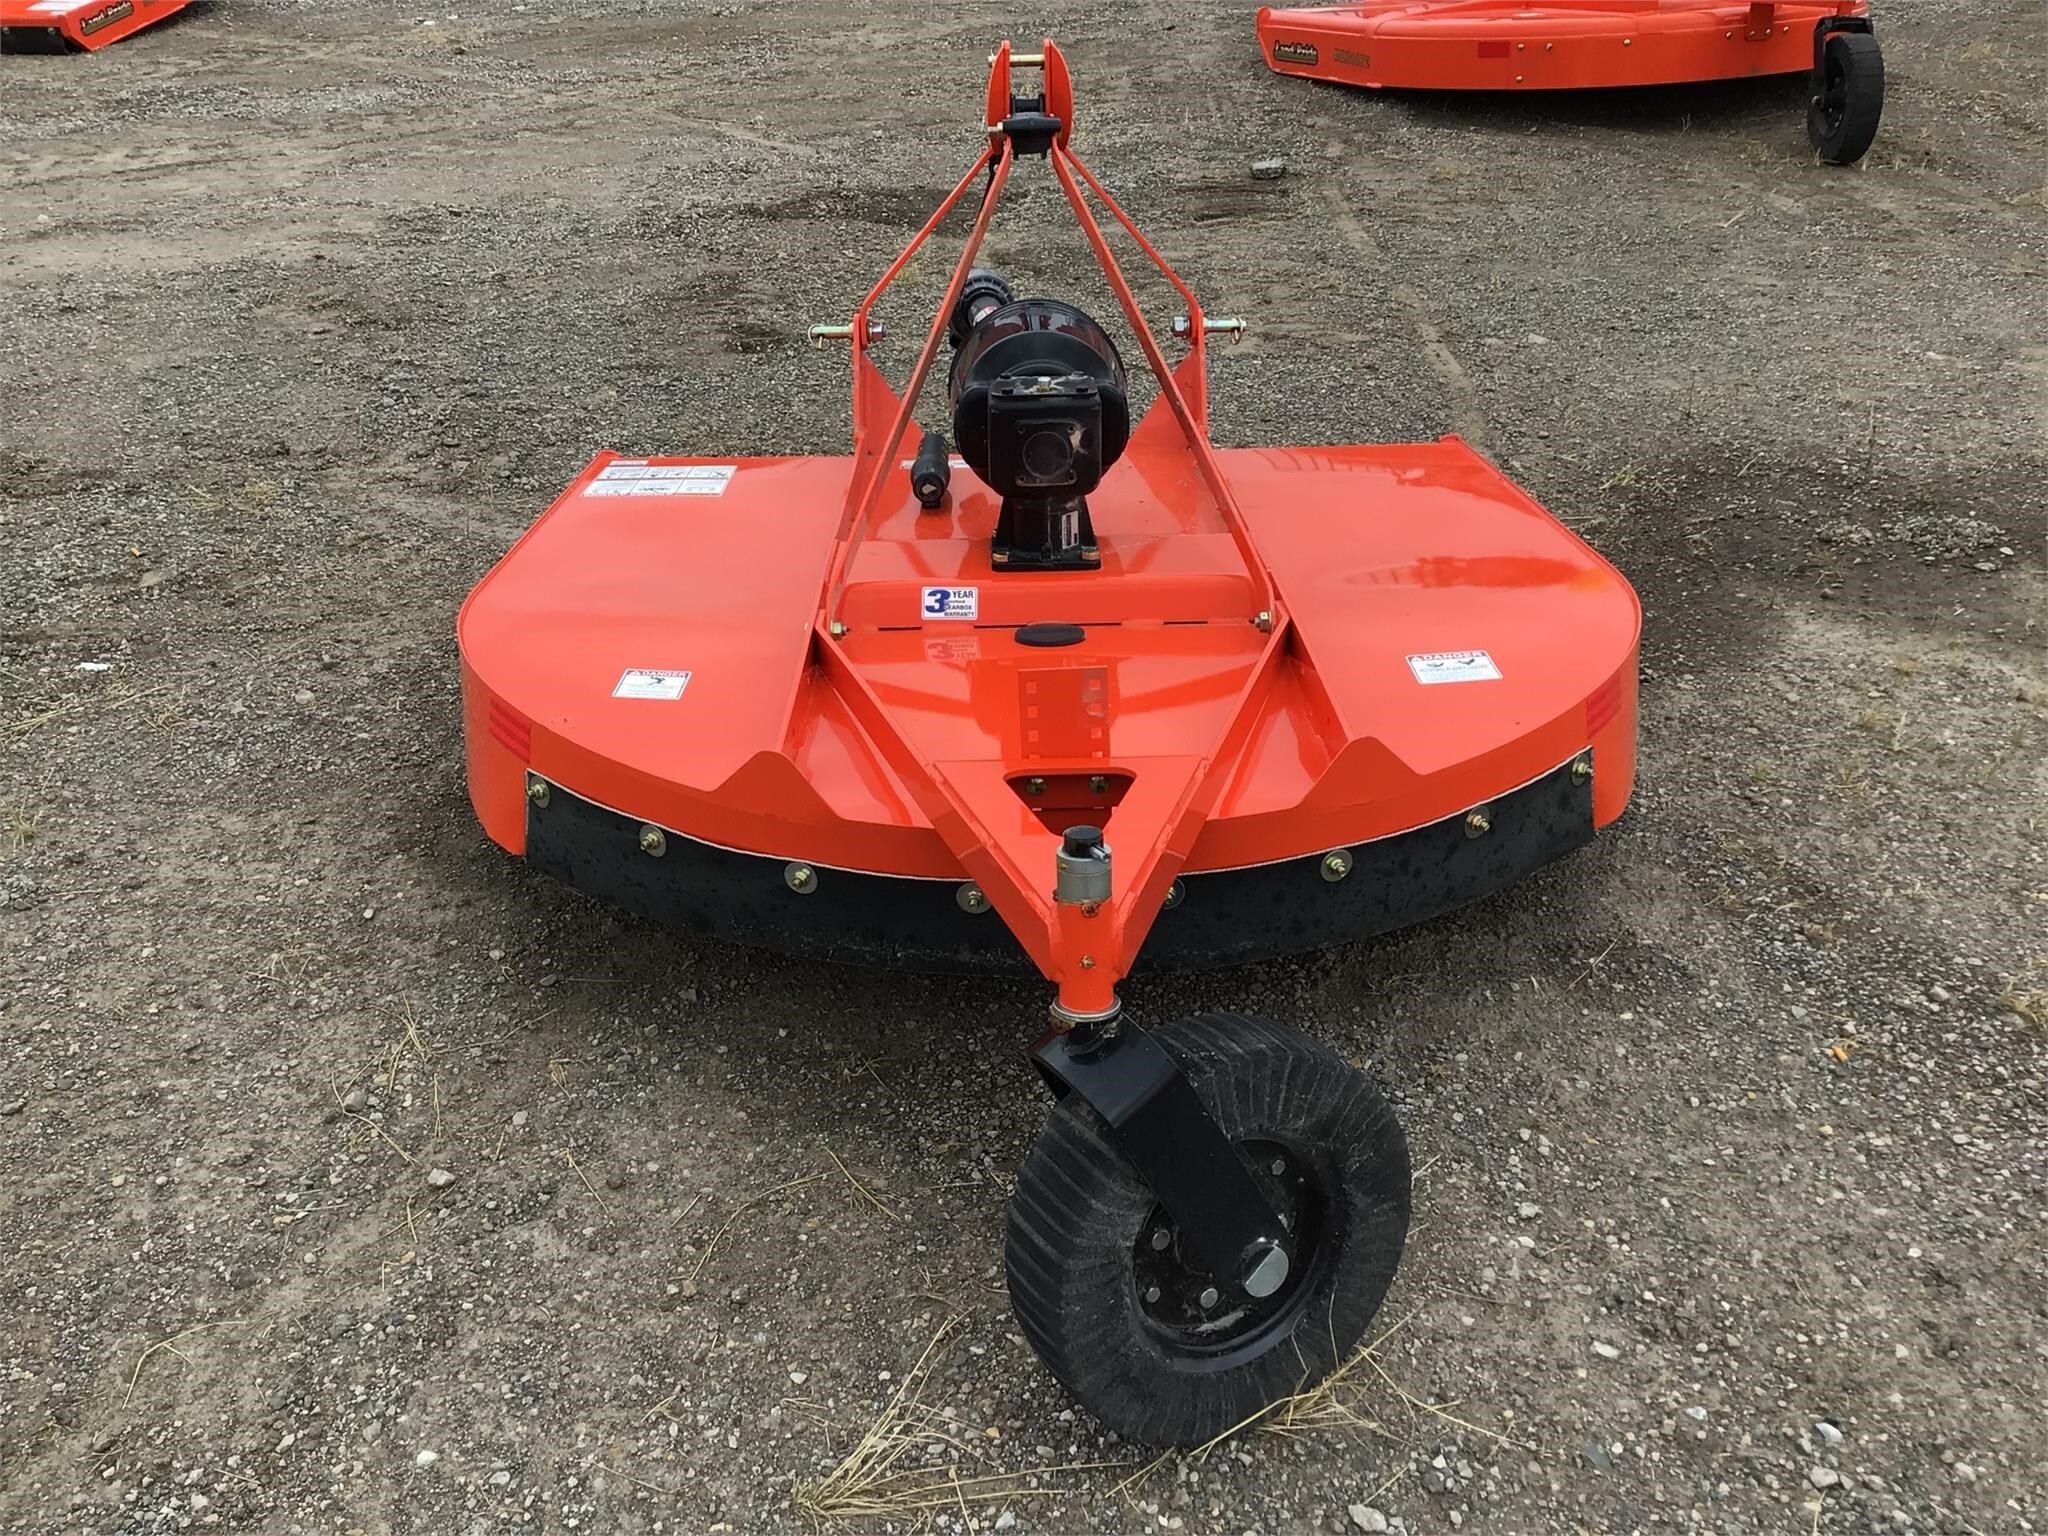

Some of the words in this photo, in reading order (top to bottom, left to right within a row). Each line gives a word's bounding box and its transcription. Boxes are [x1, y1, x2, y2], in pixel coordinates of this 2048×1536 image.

[924, 588, 951, 613] 3
[952, 590, 974, 599] YEAR
[1423, 651, 1483, 661] DANGER
[642, 670, 687, 678] DANGER
